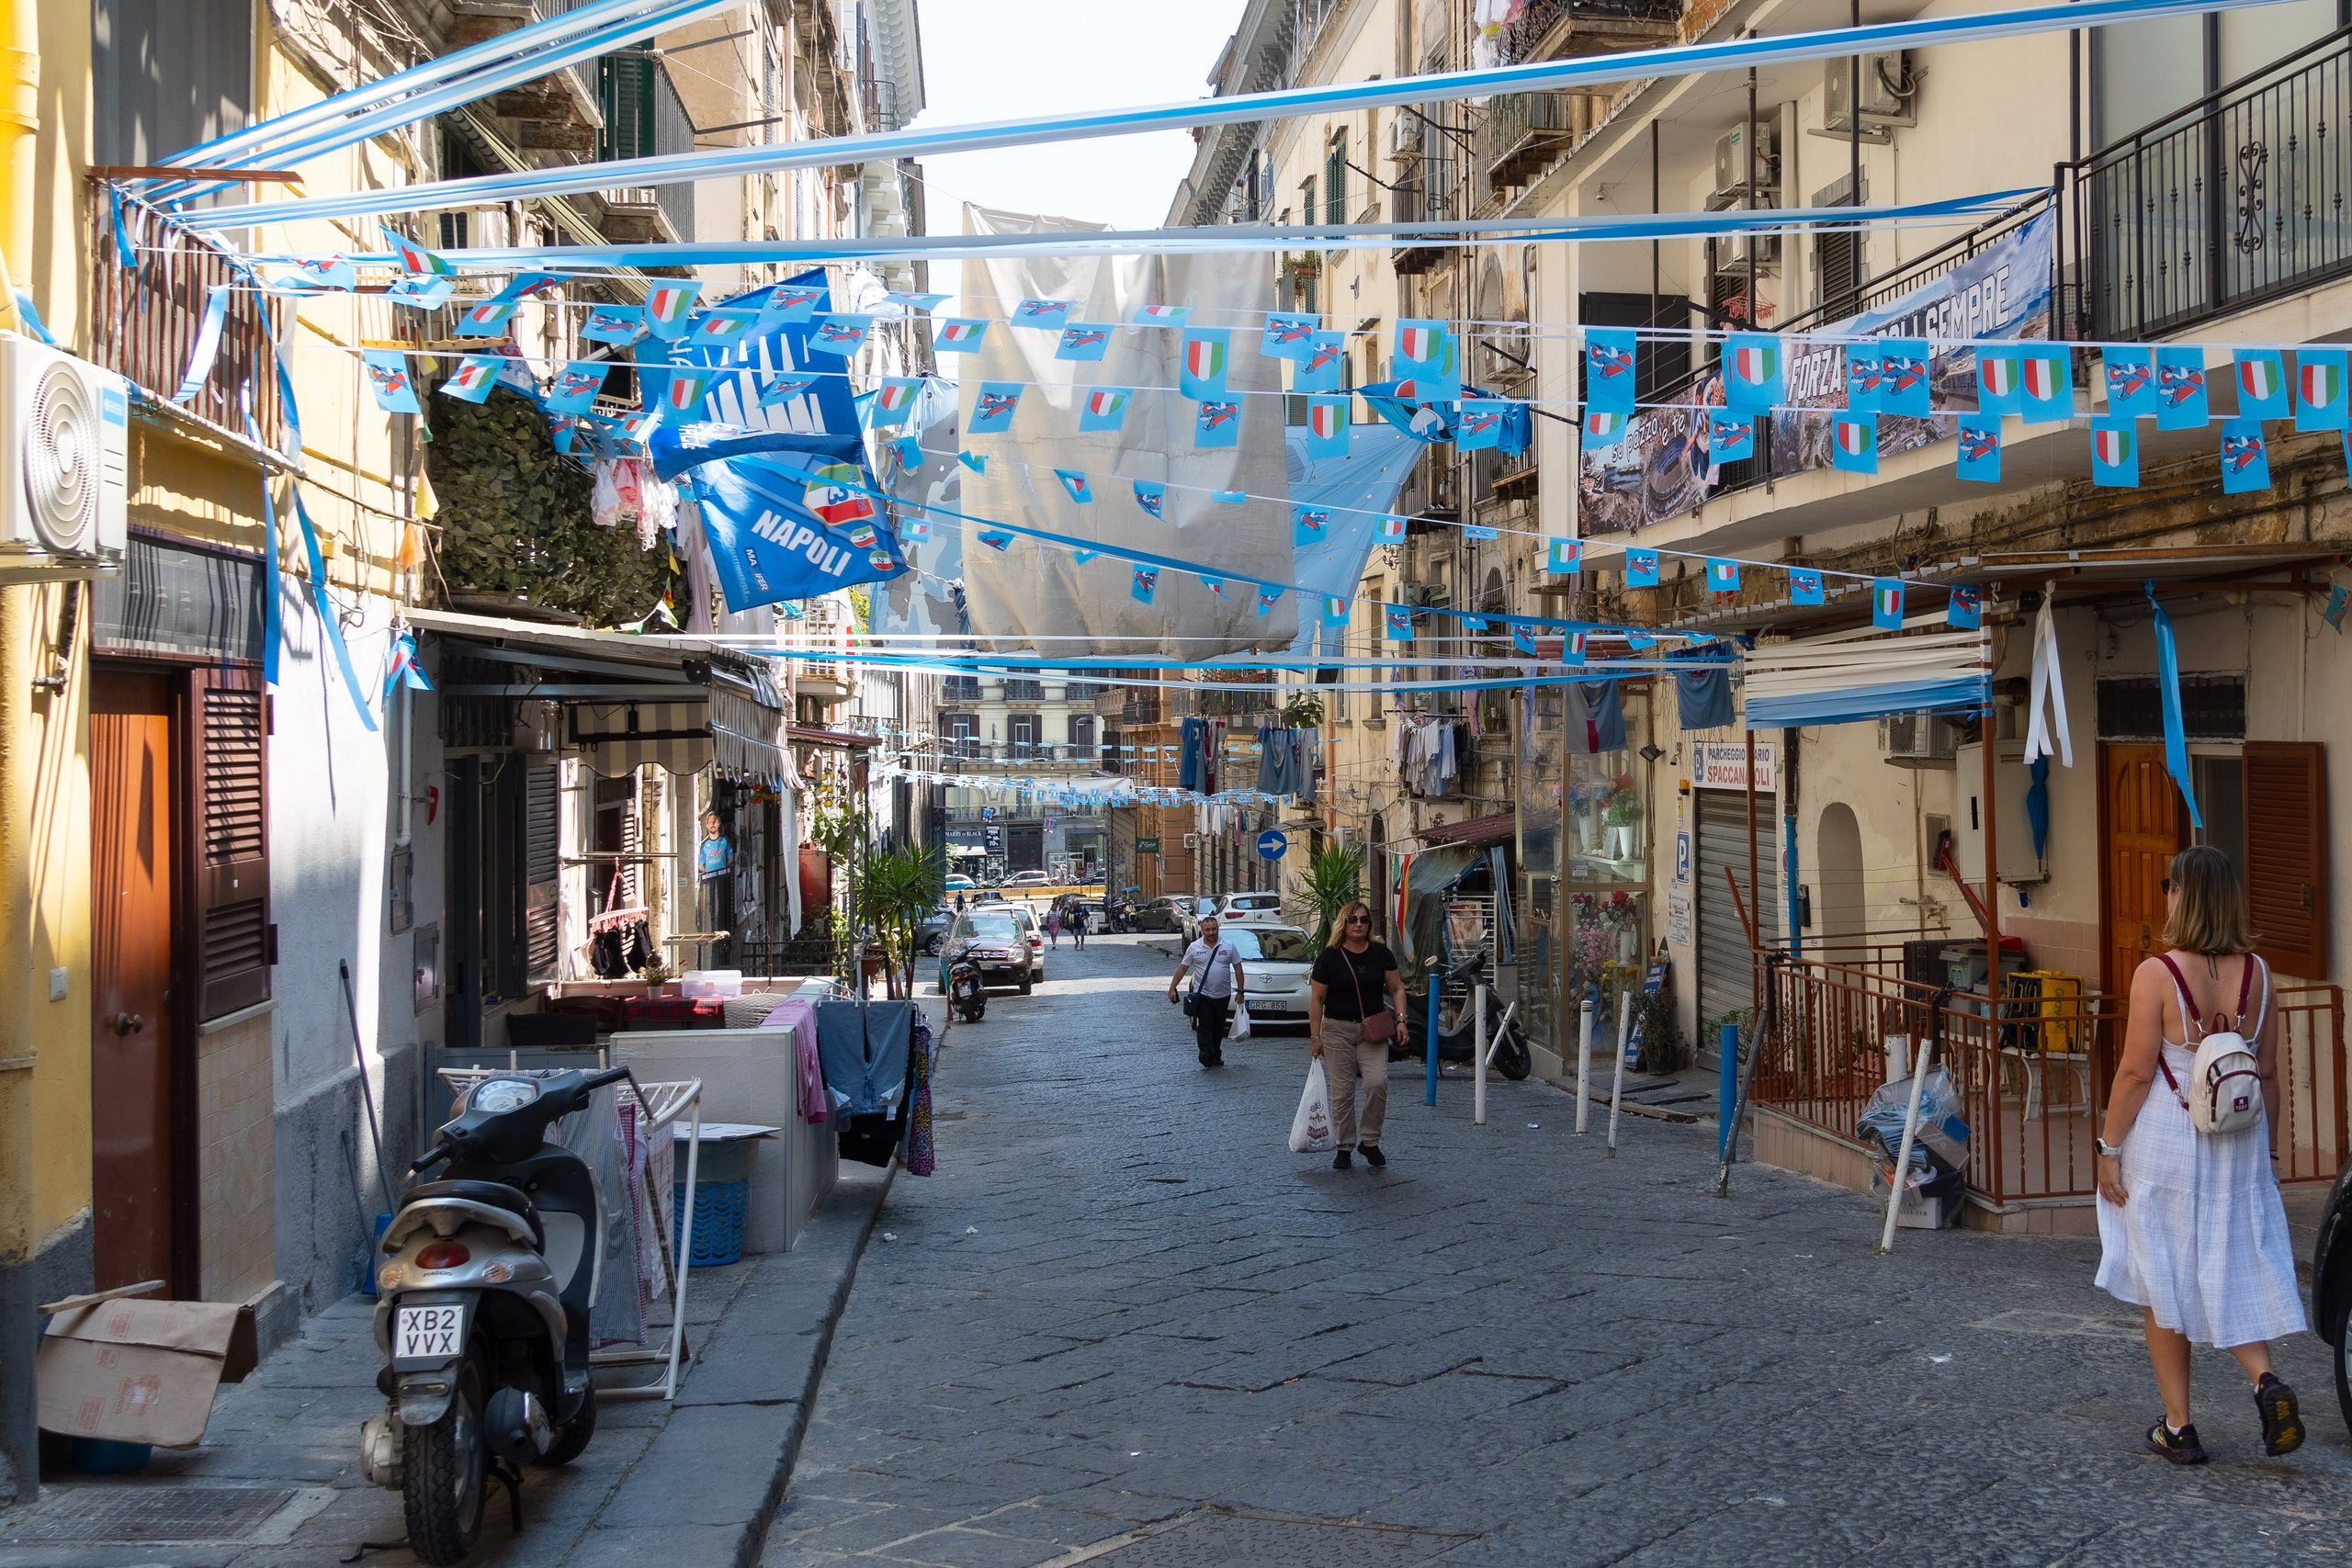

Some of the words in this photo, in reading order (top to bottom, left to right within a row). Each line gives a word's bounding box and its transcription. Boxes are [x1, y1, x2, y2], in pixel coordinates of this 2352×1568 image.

[1787, 346, 1842, 403] FORZA
[1926, 264, 2010, 360] SEMPRE
[1611, 442, 1623, 463] so
[1626, 416, 1658, 462] pazzo
[1672, 413, 1686, 437] te
[827, 486, 850, 505] 3
[752, 509, 853, 578] NAPOLI
[1709, 748, 1746, 761] PARCHEGGIO
[1708, 765, 1770, 786] SPACCANAOLI
[1679, 839, 1687, 874] P
[1250, 1001, 1266, 1010] GRG
[1271, 1001, 1285, 1010] 859
[407, 1309, 456, 1331] XB2
[406, 1332, 454, 1355] VVX
